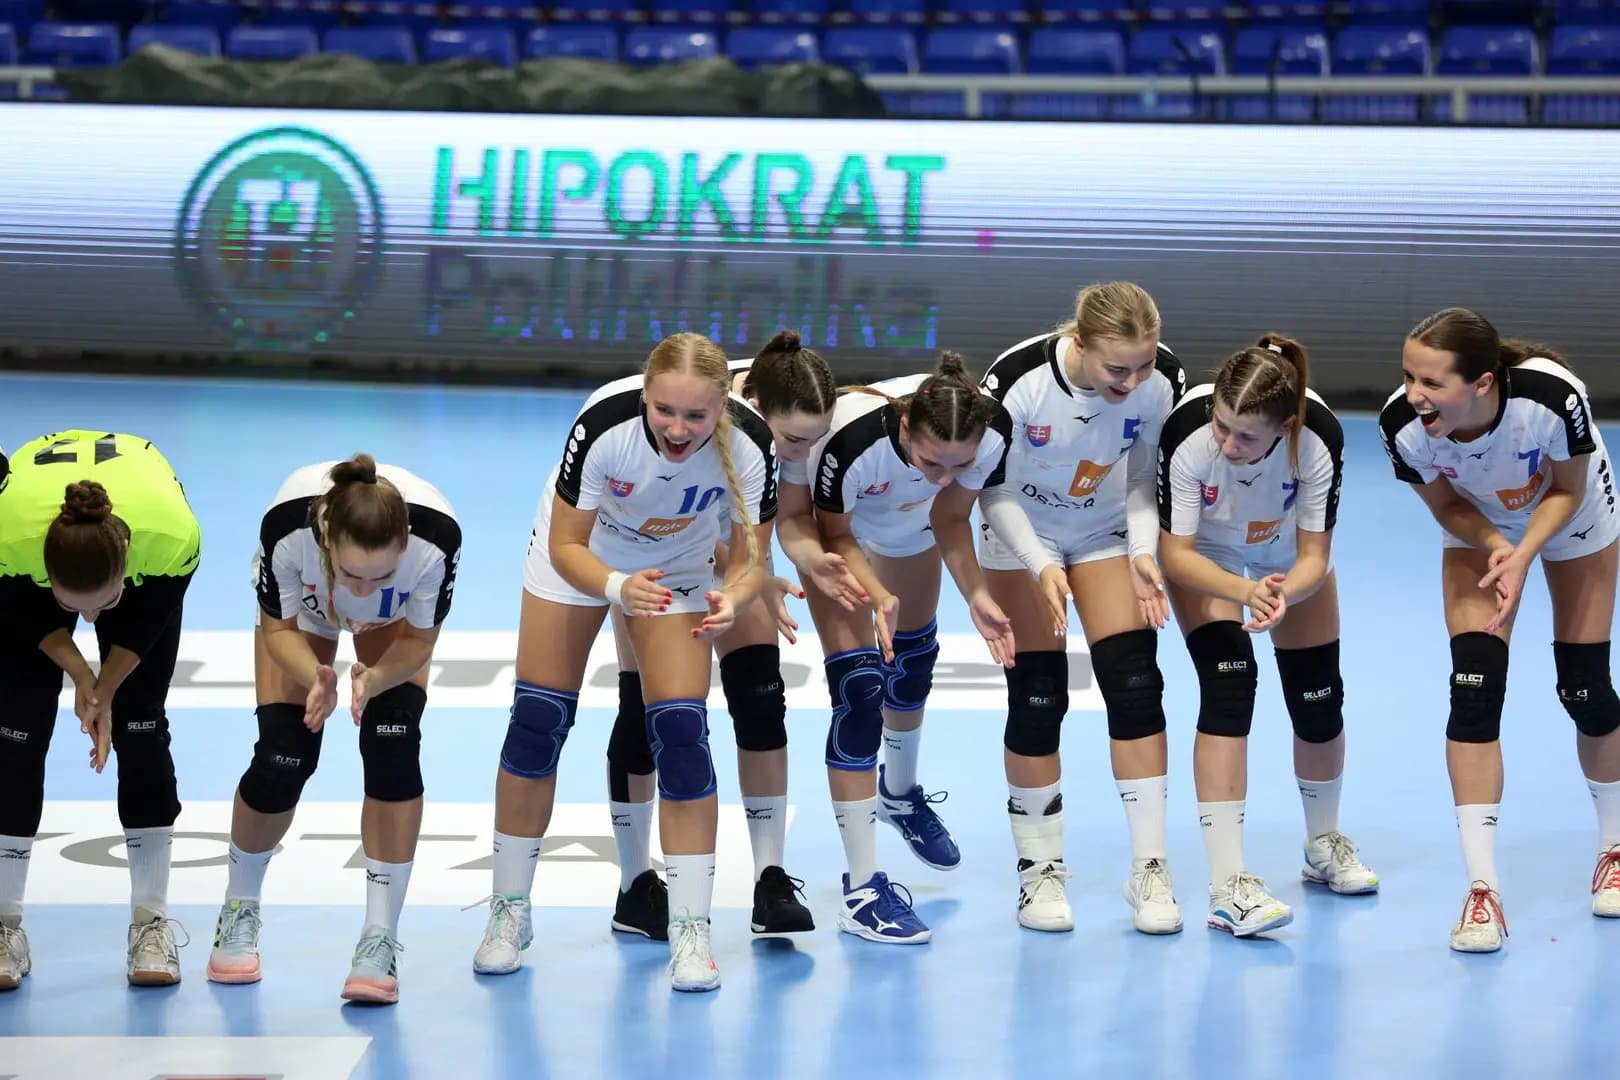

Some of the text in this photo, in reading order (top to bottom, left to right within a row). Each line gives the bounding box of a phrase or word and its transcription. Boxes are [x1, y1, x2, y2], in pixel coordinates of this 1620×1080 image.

[431, 147, 946, 247] HIPOKRAT
[676, 485, 726, 515] 10
[1218, 661, 1248, 670] SELECT
[1456, 673, 1484, 682] SELECT
[1303, 687, 1332, 699] SELECT
[127, 721, 156, 730] SELECT
[375, 724, 407, 733] SELECT
[0, 726, 28, 740] SELECT
